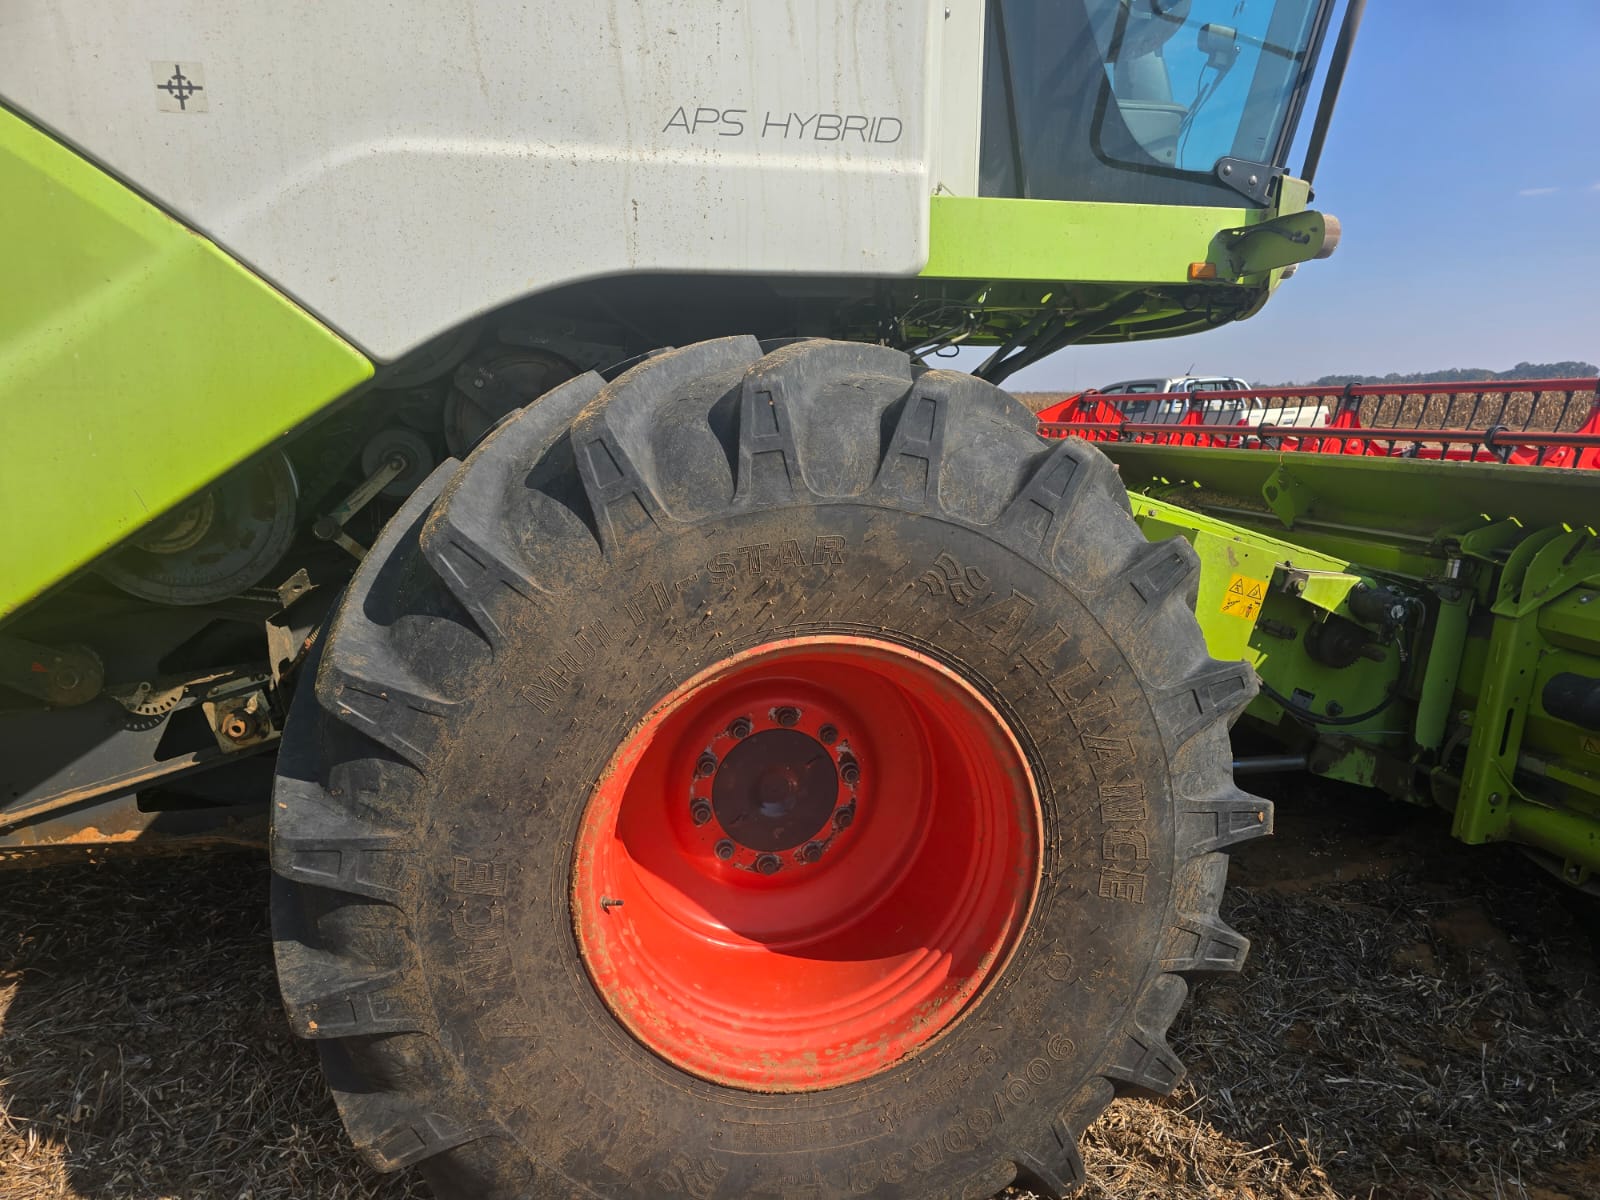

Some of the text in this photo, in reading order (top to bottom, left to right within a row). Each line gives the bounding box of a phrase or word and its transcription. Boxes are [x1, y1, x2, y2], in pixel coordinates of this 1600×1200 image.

[662, 106, 903, 143] APS HYBRID
[955, 588, 1149, 904] ALLIANCE
